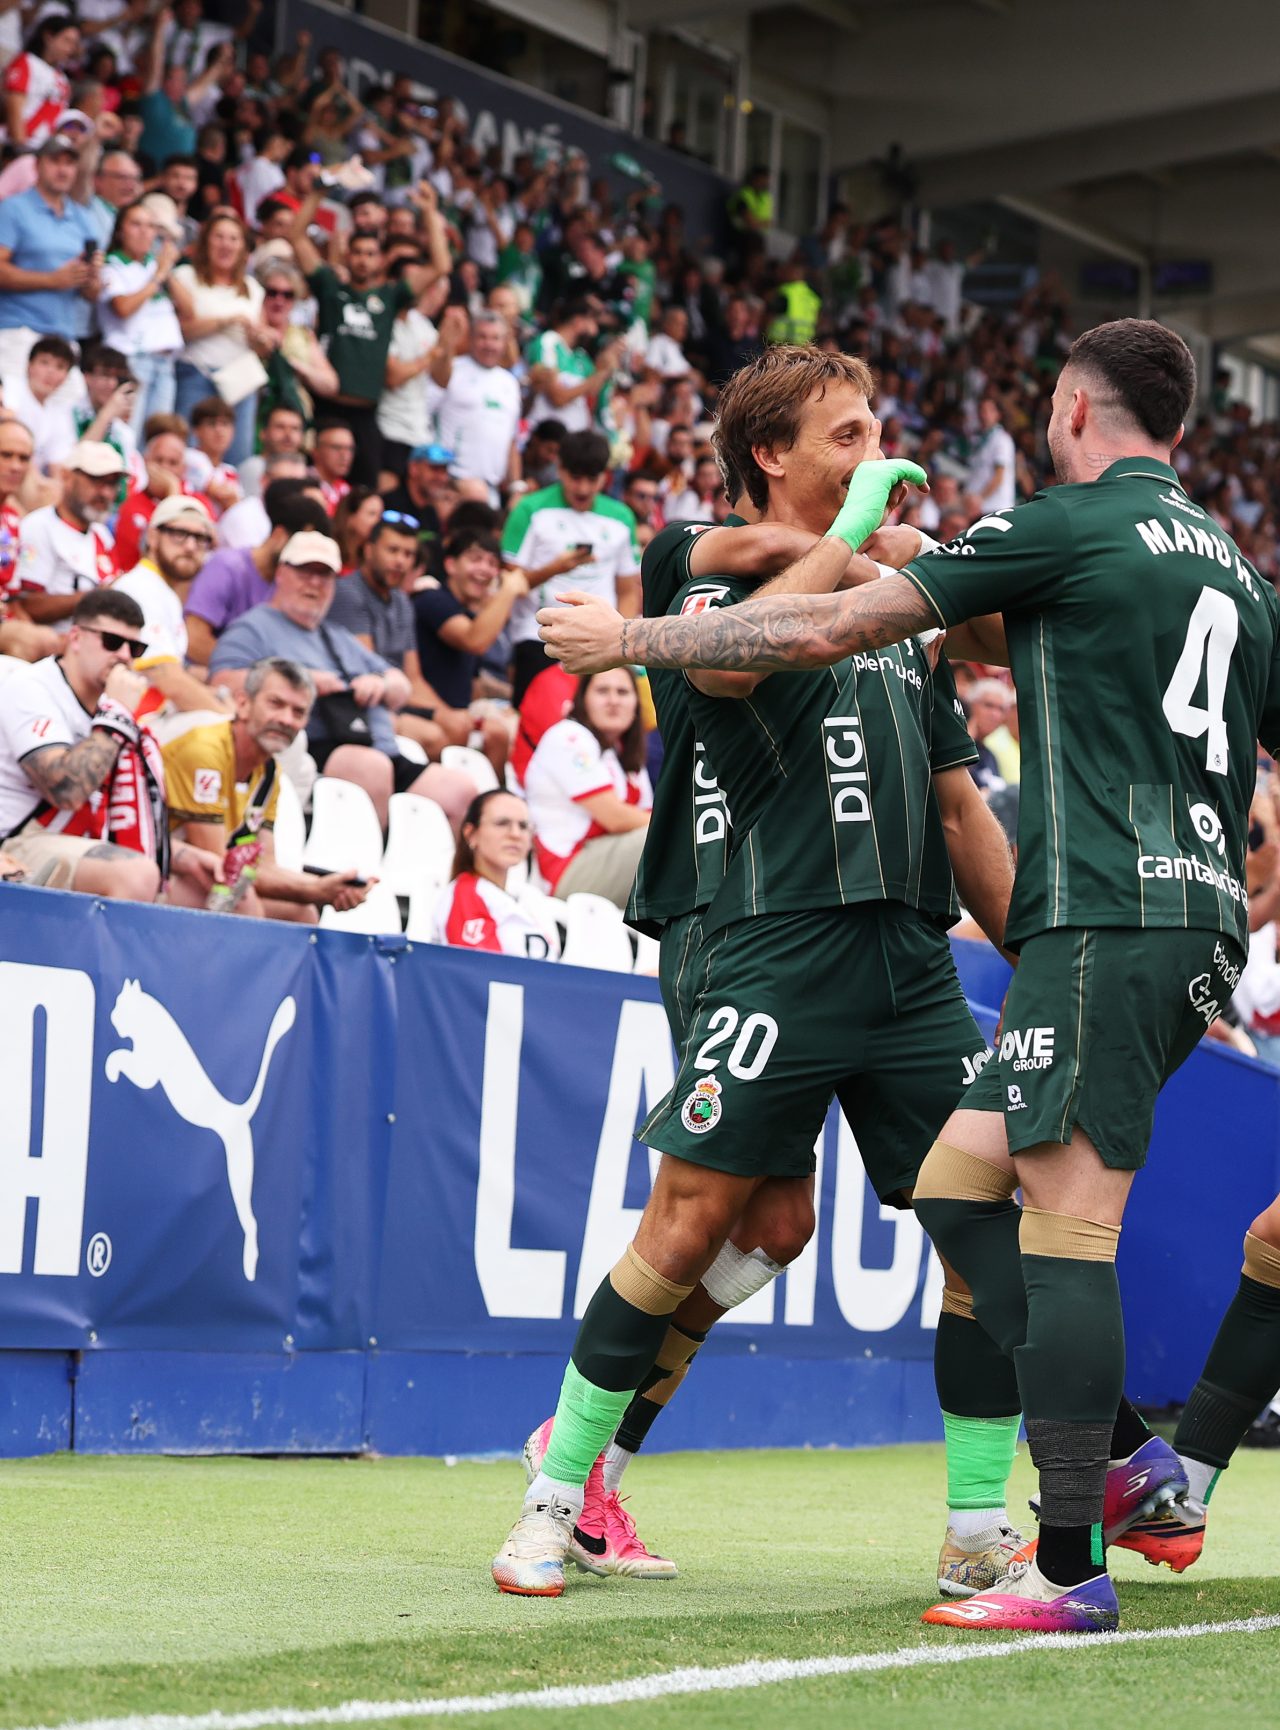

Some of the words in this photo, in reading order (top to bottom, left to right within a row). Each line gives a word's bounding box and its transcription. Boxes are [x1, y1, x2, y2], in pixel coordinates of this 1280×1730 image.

[1158, 494, 1205, 520] Santander
[1135, 518, 1232, 568] MANU
[1162, 585, 1239, 776] 4
[823, 716, 871, 823] DIGI
[694, 1006, 779, 1080] 20
[1013, 1057, 1053, 1072] GROUP
